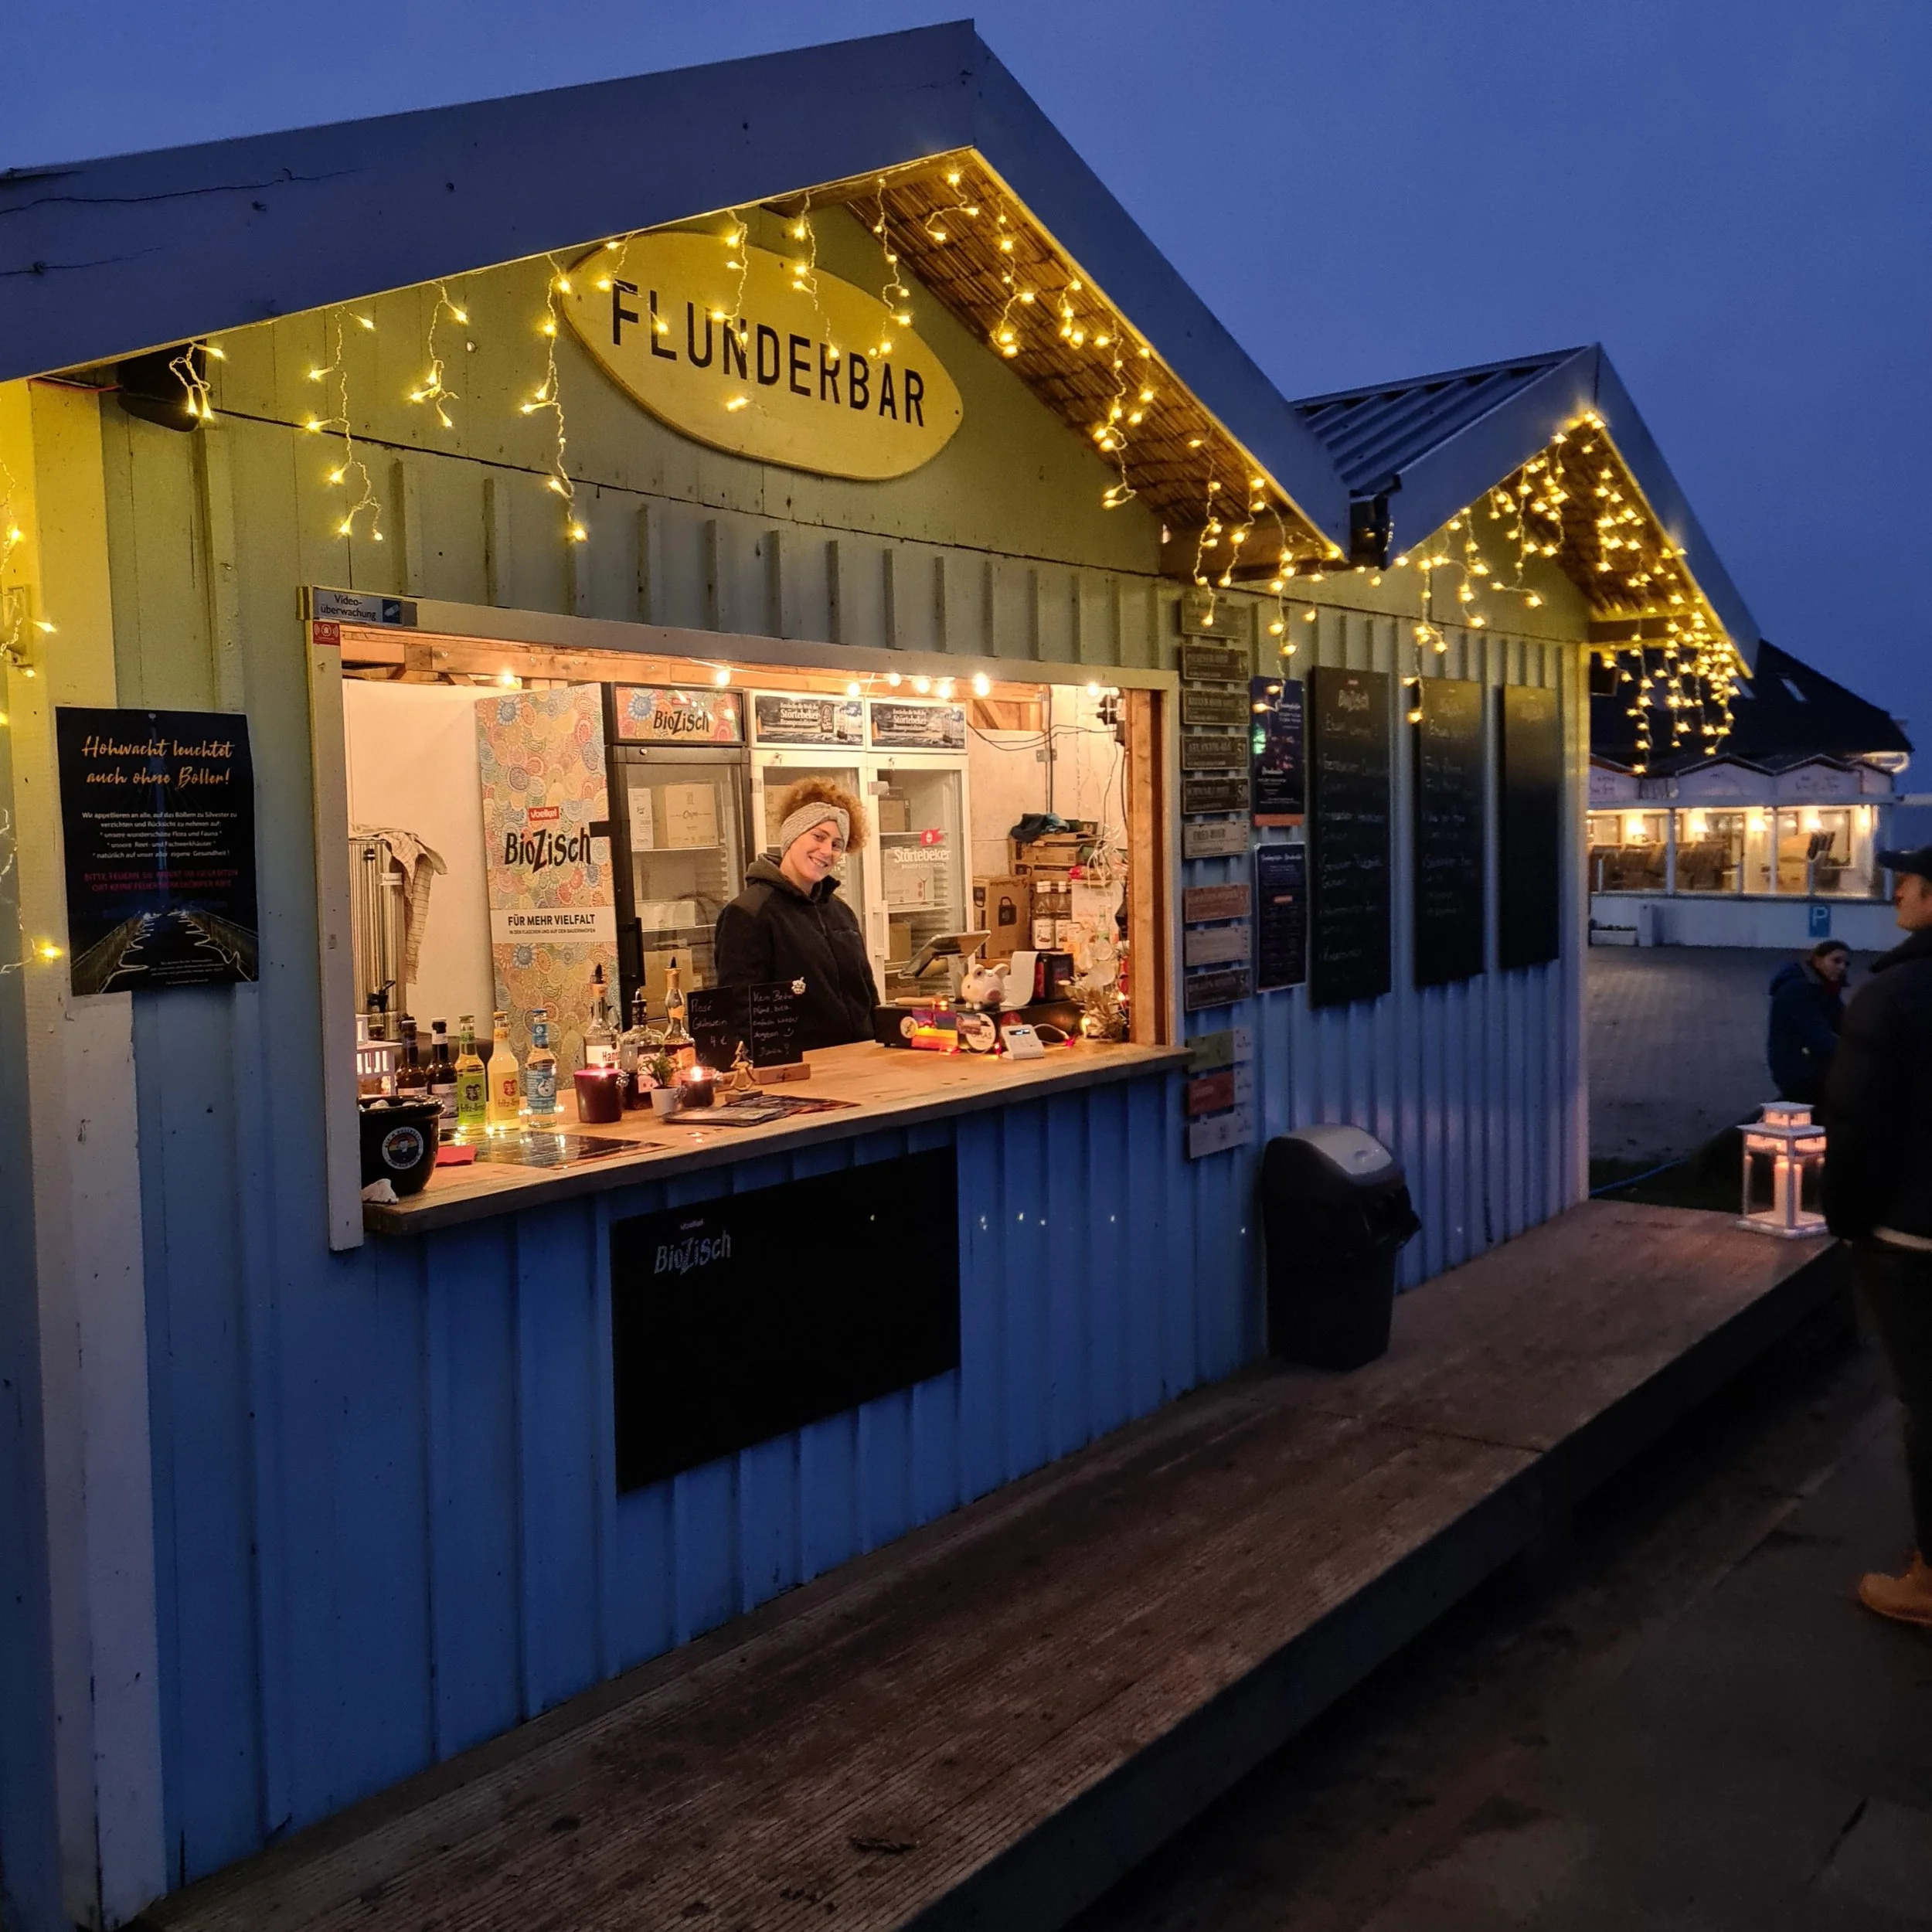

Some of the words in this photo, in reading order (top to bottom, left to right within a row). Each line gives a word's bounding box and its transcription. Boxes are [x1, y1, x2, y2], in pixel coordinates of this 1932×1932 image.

[612, 278, 924, 427] FLUNDERBAR
[334, 594, 362, 606] Video-
[320, 604, 376, 621] überwachung
[653, 709, 709, 735] BioZisch
[780, 709, 820, 719] Störtebeker
[893, 715, 927, 724] Störtebeker
[81, 735, 172, 758] Hohwacht
[172, 740, 235, 758] leuchtet
[86, 767, 128, 784] auch
[132, 767, 172, 784] ohne
[505, 827, 592, 873] BioZisch
[894, 849, 951, 863] Störtebeker
[508, 914, 525, 926] FÜR
[527, 916, 553, 926] MEHR
[554, 914, 596, 925] VIELFALT
[1812, 906, 1828, 927] P
[692, 998, 713, 1013] Rosé
[710, 1036, 716, 1047] 4
[654, 1228, 732, 1277] BioZisch
